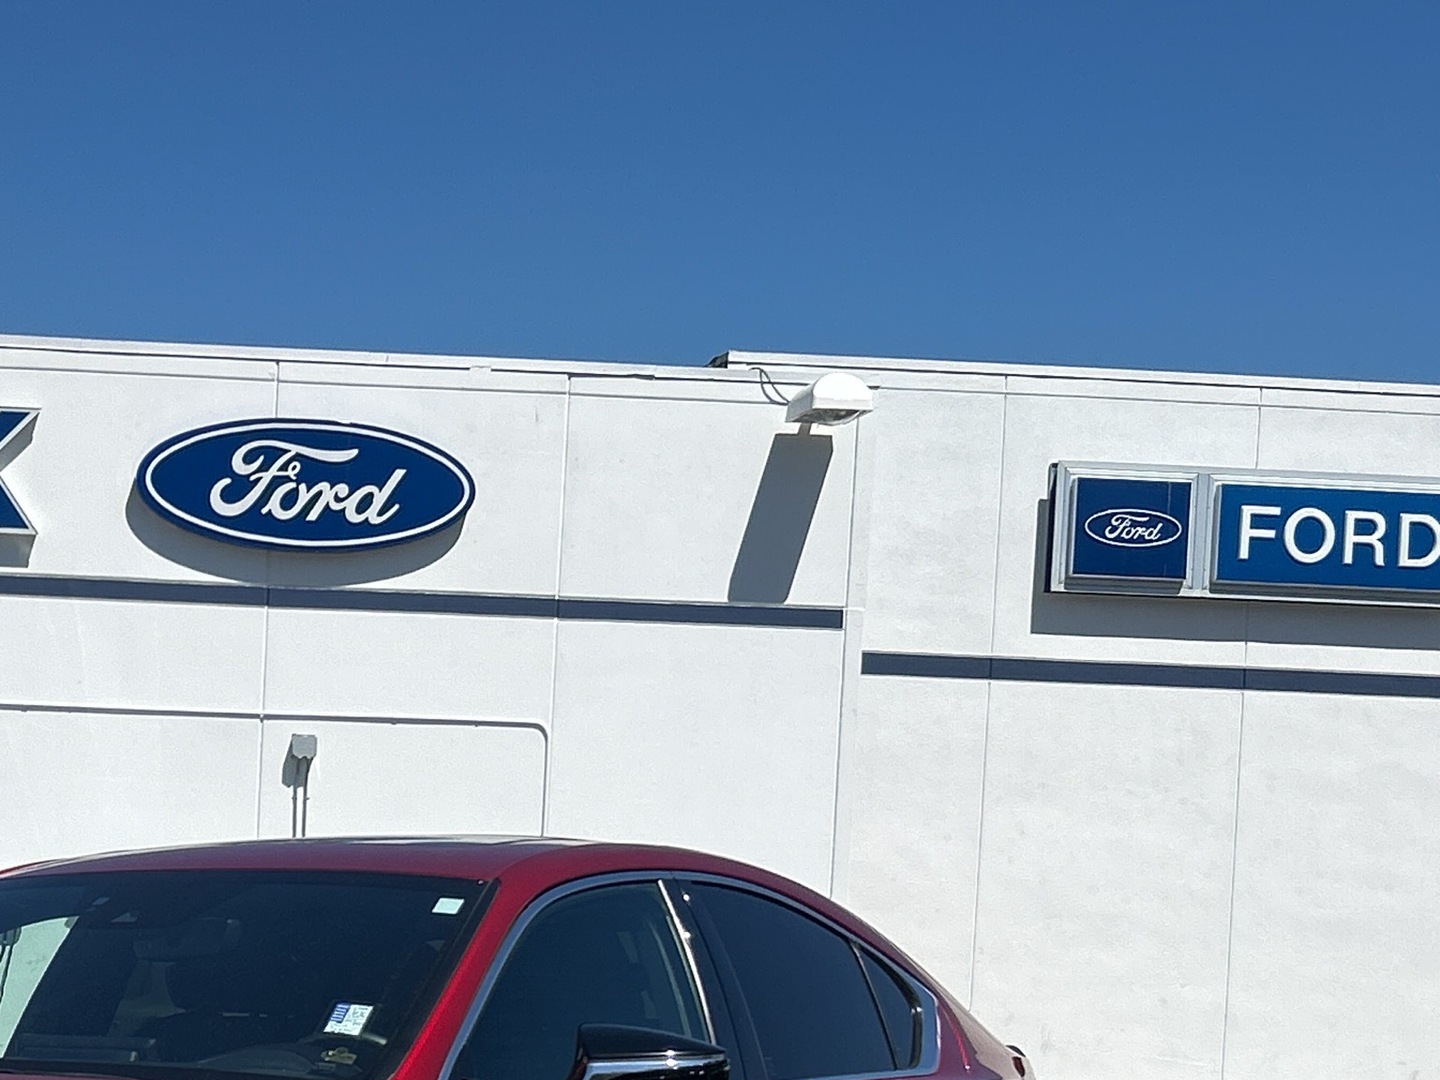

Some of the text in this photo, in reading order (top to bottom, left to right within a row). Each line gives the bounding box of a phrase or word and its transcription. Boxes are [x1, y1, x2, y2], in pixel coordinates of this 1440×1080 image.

[210, 439, 407, 525] Ford
[1104, 513, 1164, 541] Ford
[1237, 504, 1440, 568] FORD
